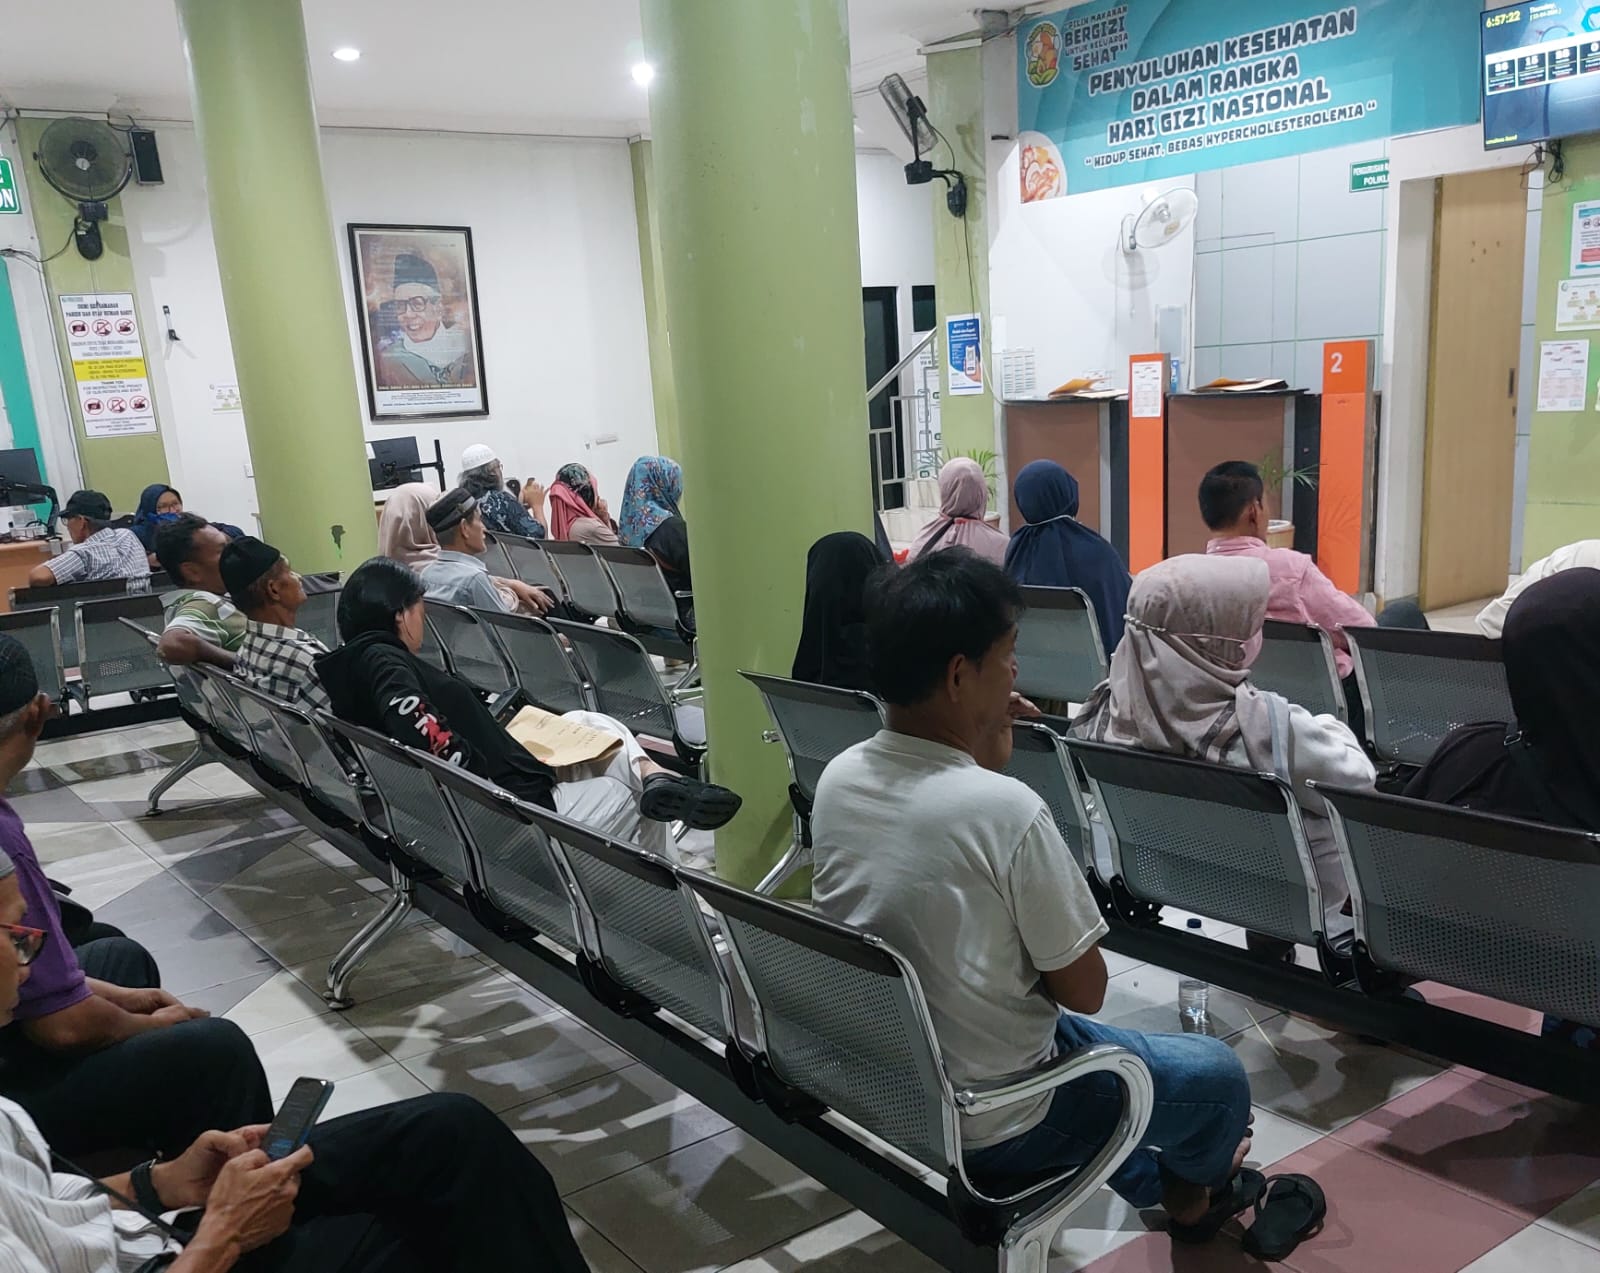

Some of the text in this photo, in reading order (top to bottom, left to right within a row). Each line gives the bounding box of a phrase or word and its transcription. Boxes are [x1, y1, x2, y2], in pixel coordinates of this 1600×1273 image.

[1065, 16, 1125, 46] BERGIZI
[1089, 8, 1355, 95] PENYULUHAN KESEHATAN
[1109, 79, 1329, 143] HARI GIZI NASIONAL
[1133, 55, 1298, 112] DALAM RANGKA
[1094, 151, 1126, 167] HIDUP
[1168, 136, 1203, 153] BEBAS
[1206, 104, 1364, 146] HYPERCHOLESTEROLEMIA
[1330, 352, 1343, 373] 2
